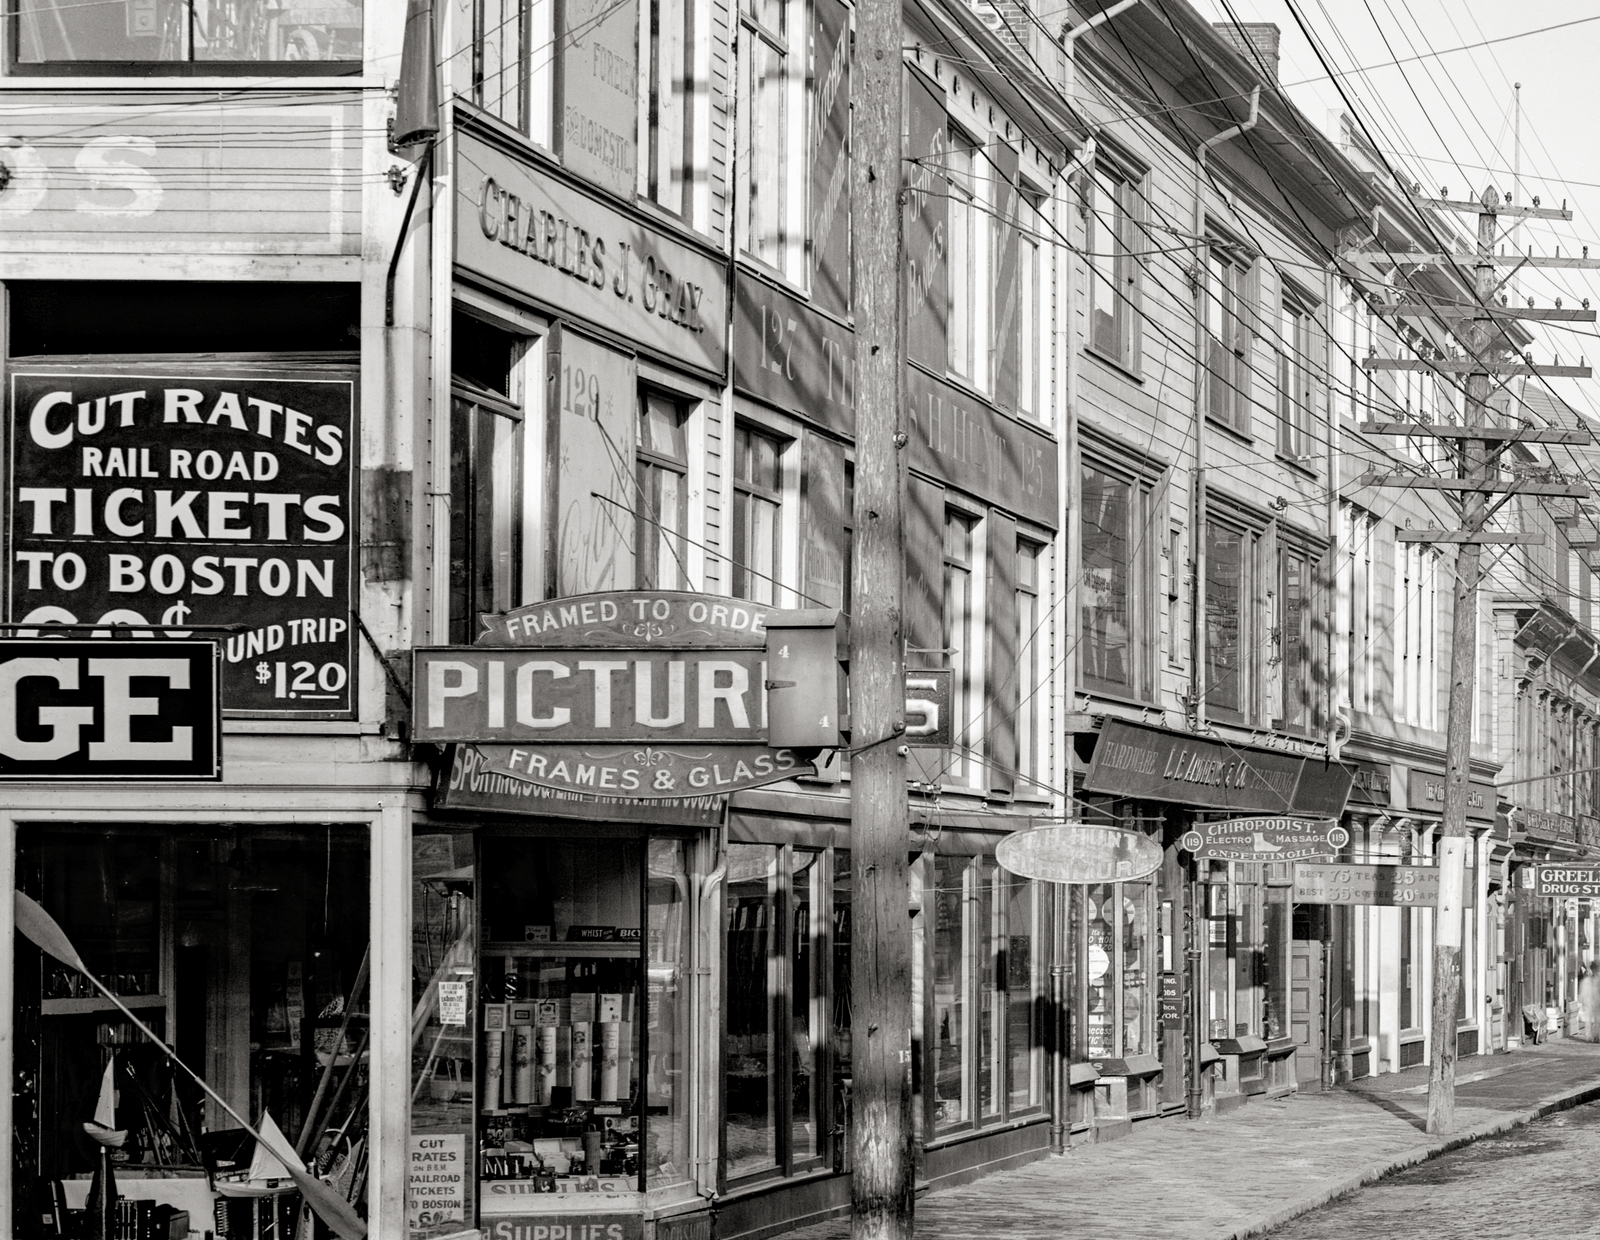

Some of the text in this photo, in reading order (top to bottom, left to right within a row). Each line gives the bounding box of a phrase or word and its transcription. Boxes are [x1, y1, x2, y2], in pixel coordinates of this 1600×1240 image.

[478, 174, 606, 291] CHARLES
[613, 241, 634, 304] J.
[760, 304, 798, 381] 127
[563, 364, 600, 424] 129
[29, 388, 343, 466] CUT RATES
[82, 447, 280, 481] RAIL ROAD
[19, 487, 346, 542] TICKETS
[16, 551, 335, 598] TO BOSTON
[506, 599, 767, 640] FRAMED TO ORDE
[287, 617, 348, 646] TRIP
[778, 645, 790, 659] 4
[427, 660, 768, 729] PICTUR
[818, 715, 830, 728] 4
[1100, 741, 1159, 775] HARDWARE
[508, 749, 797, 791] FRAMES & GLASS
[1208, 820, 1317, 836] CHIROPODIST.
[1186, 838, 1200, 847] 119
[1206, 836, 1252, 845] ELECTRO
[1331, 833, 1345, 842] 119
[1299, 871, 1324, 879] BEST
[1356, 872, 1385, 881] TEAS
[1299, 888, 1324, 897] BEST
[1354, 890, 1390, 898] COFFEE
[1541, 884, 1600, 895] DRUG ST
[581, 929, 603, 939] WHIST
[419, 1139, 446, 1149] CUT
[411, 1151, 457, 1162] RATES
[410, 1174, 461, 1183] RAILROAD
[410, 1186, 456, 1196] TICKETS
[422, 1199, 461, 1209] BOSTON
